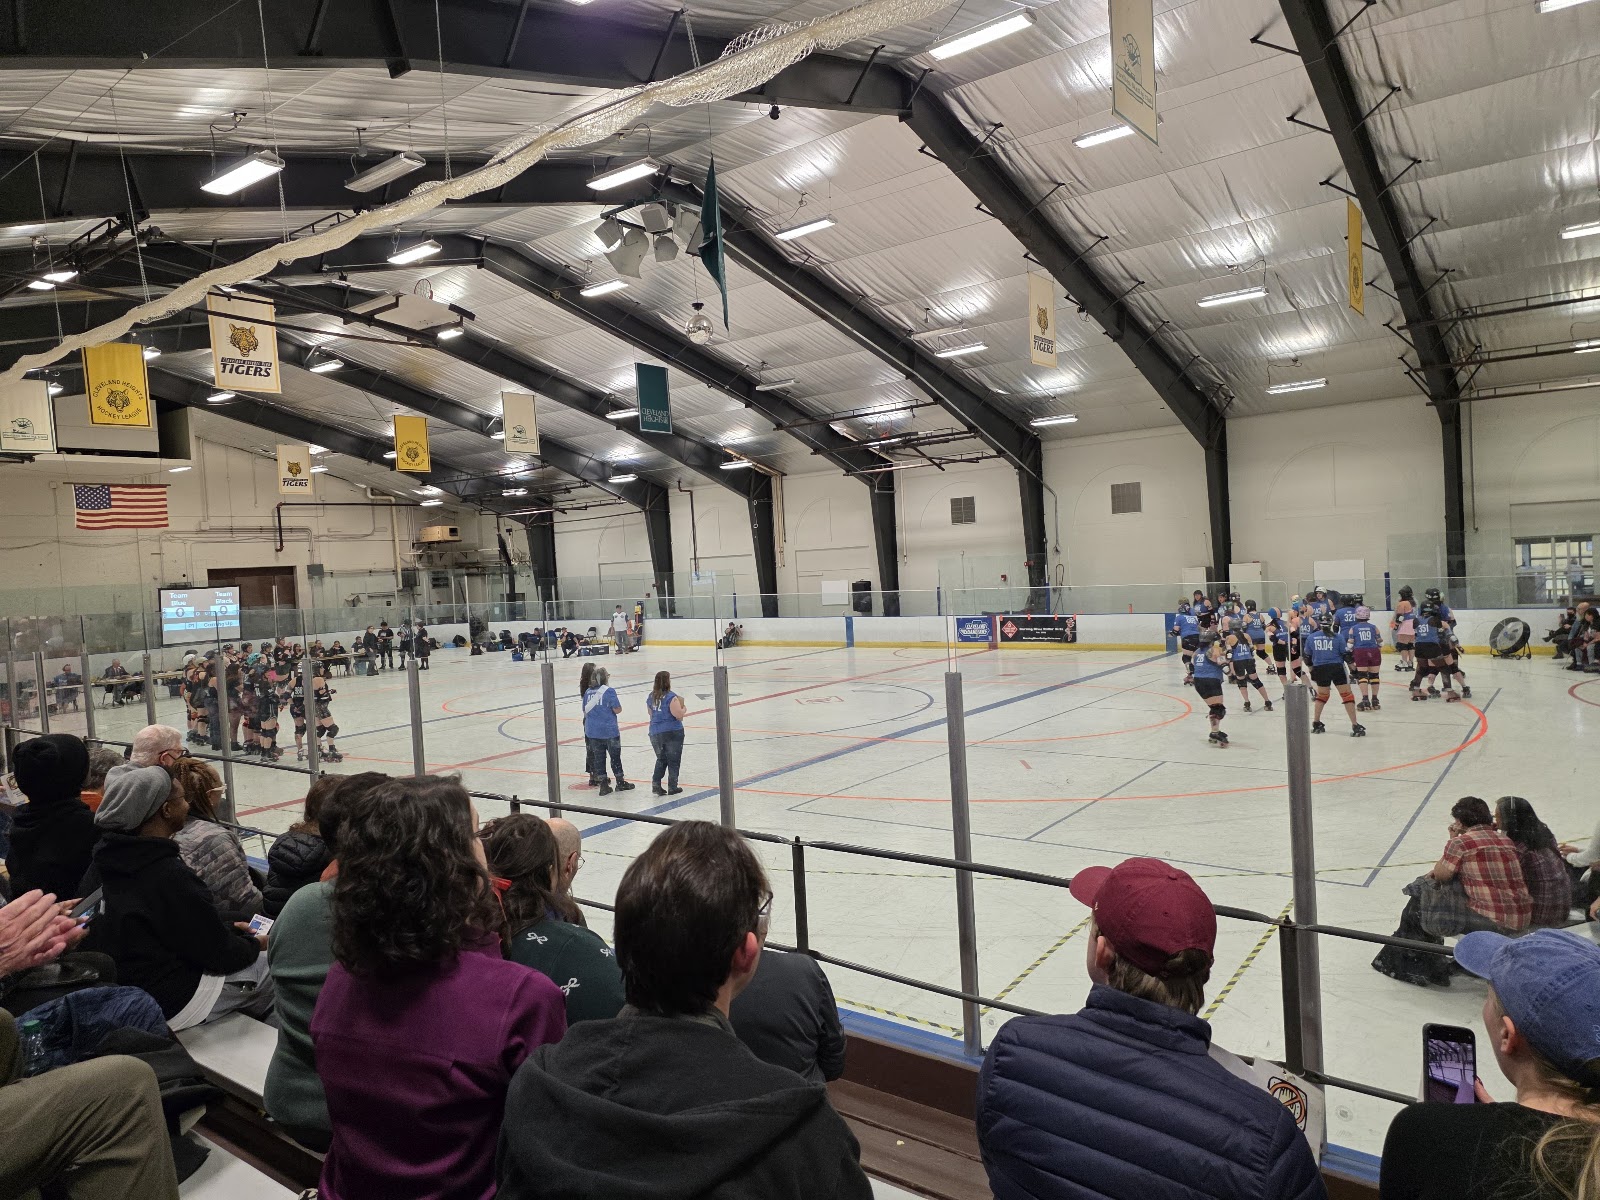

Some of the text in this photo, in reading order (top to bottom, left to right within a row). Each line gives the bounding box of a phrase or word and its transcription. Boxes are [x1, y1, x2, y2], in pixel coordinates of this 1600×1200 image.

[1034, 340, 1053, 354] TIGERS
[220, 363, 272, 377] TIGERS
[93, 380, 144, 400] CLEVELAND HEIGHTS
[97, 405, 142, 419] HOCKEY LEAGUE
[1314, 640, 1333, 651] 19.04
